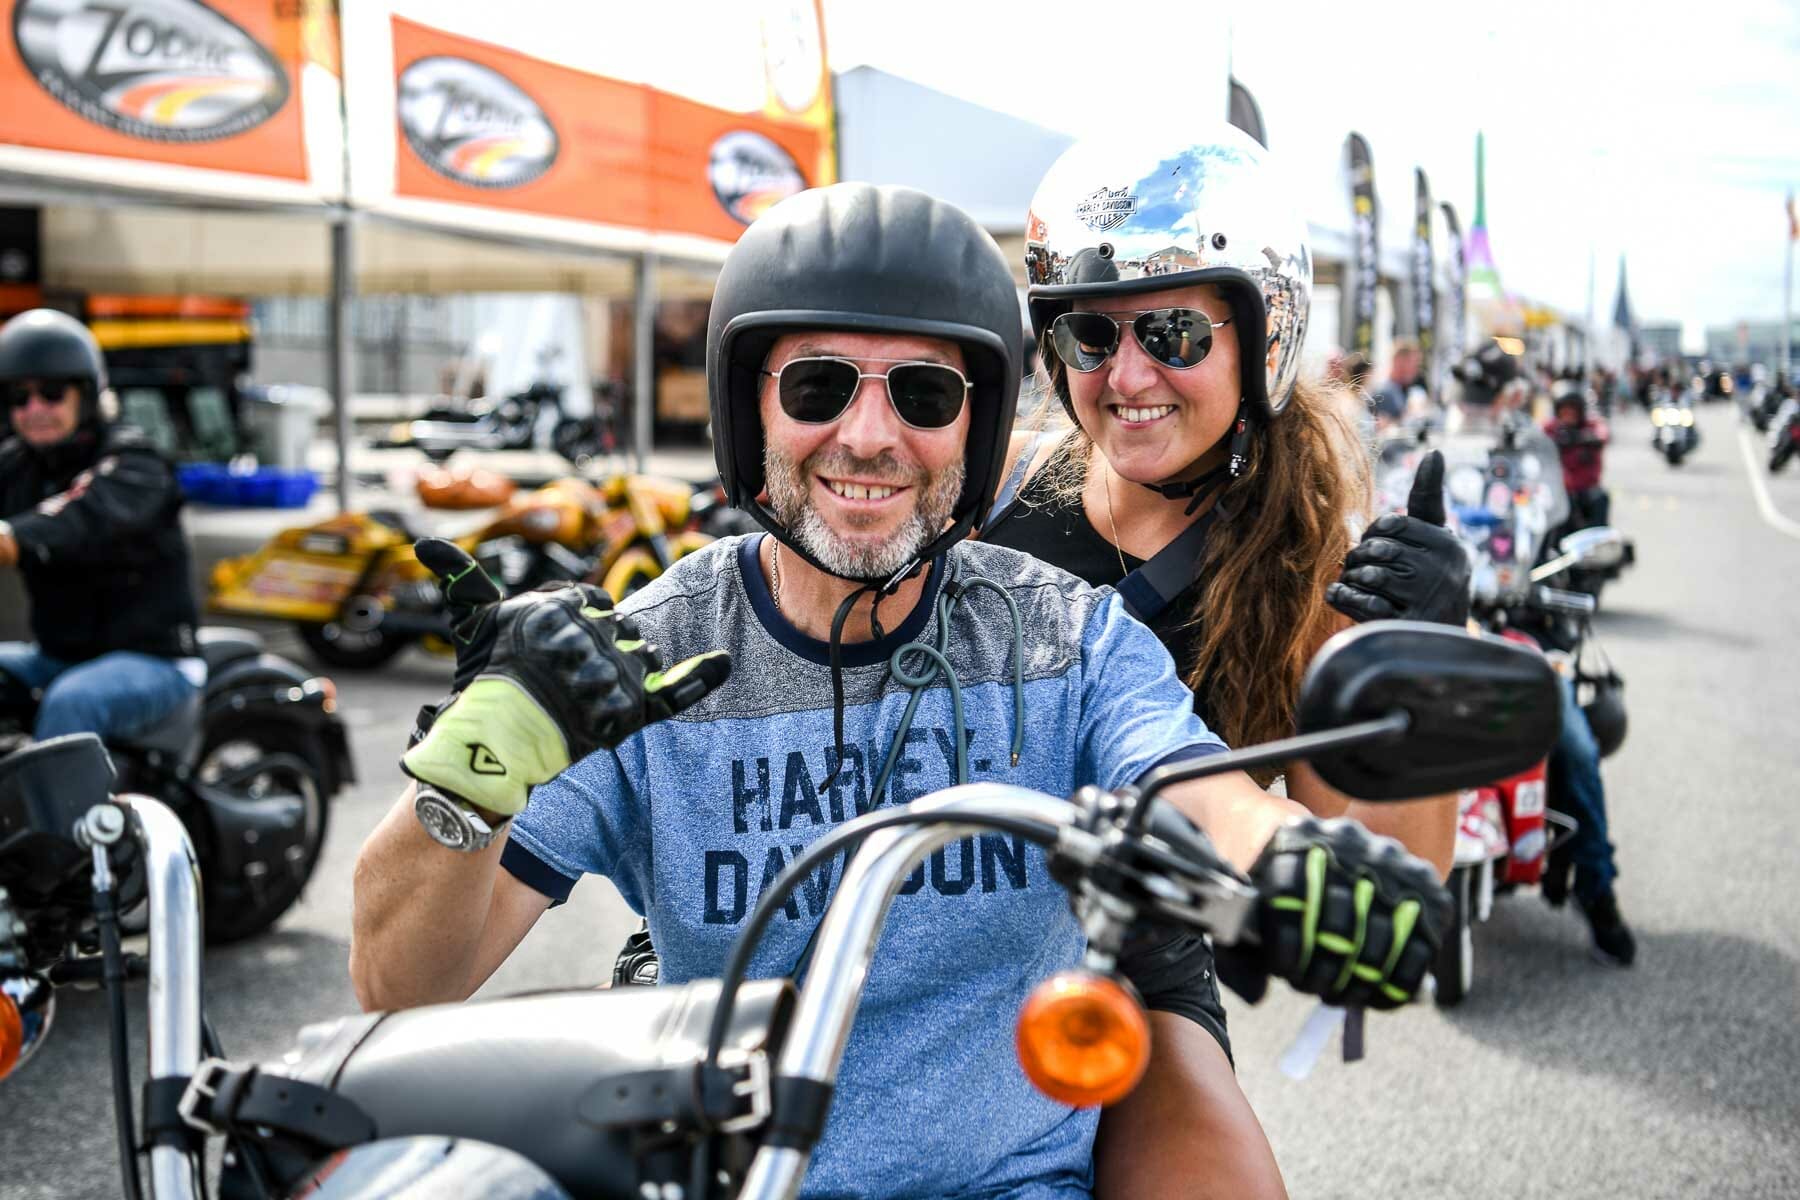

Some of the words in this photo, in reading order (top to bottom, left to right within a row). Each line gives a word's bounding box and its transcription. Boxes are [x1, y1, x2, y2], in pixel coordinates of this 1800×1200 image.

[84, 2, 231, 77] ZOD
[731, 727, 993, 834] HARLEY-
[703, 832, 1028, 924] DAVON
